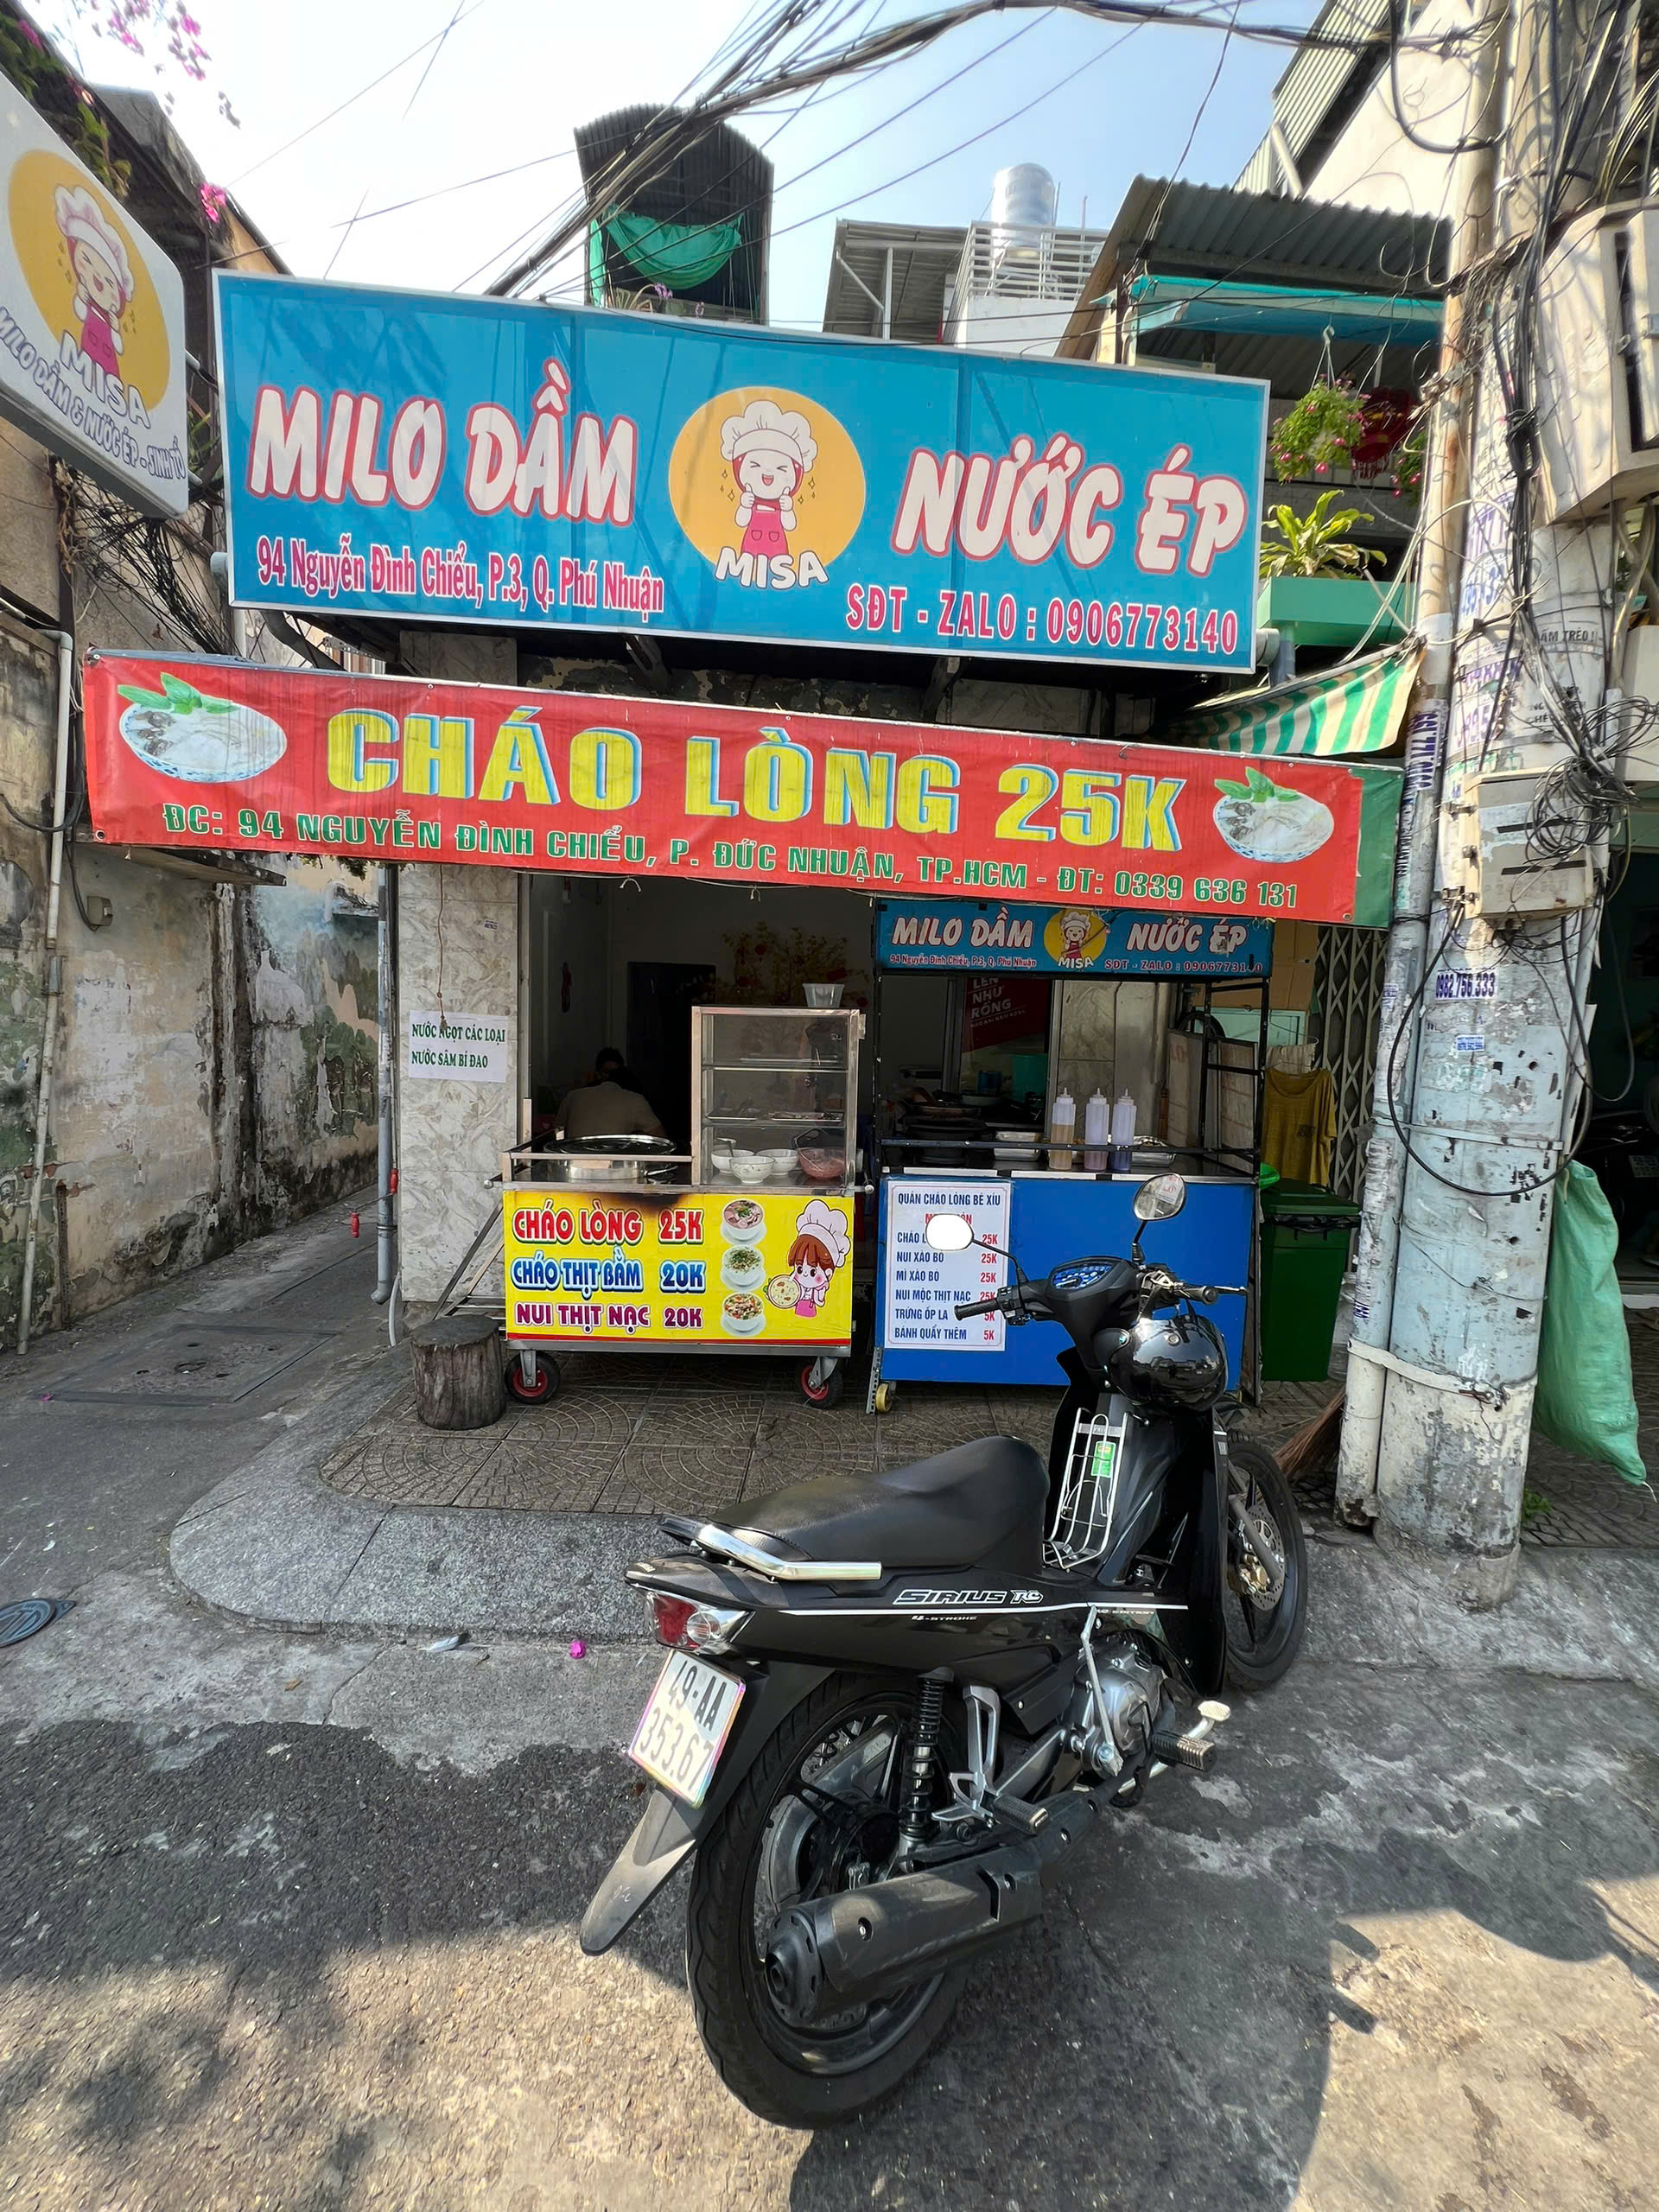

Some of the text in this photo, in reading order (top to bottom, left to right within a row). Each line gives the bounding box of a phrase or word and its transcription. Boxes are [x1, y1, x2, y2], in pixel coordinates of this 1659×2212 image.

[0, 306, 37, 370] MILO
[60, 329, 151, 429] MISA
[249, 359, 635, 524] MILO DẦM
[893, 432, 1249, 576] NƯỚC ÉP
[257, 533, 664, 623] 94 Nguyễn Đình Chiểu, P.3, Q. Phú Nhuận
[715, 546, 830, 589] MISA
[845, 582, 908, 632] SĐT
[937, 589, 1017, 641] ZALO
[1046, 597, 1238, 654] 0906773140
[327, 705, 1187, 852] CHÁO LÒNG 25K
[162, 803, 223, 835] ĐC:
[238, 809, 283, 839] 94
[296, 809, 442, 849] NGUYỄN
[454, 821, 534, 856] ĐÌNH
[547, 825, 657, 867] CHIỂU,
[670, 838, 699, 866] P.
[713, 838, 776, 870] ĐỨC
[788, 846, 905, 883] NHUẬN,
[917, 856, 1027, 888] TP.HCM
[1057, 866, 1104, 893] ĐT:
[1115, 871, 1184, 899] 0339
[1193, 877, 1248, 904] 636
[1257, 881, 1298, 908] 131
[892, 906, 1034, 948] MILO DẦM
[1126, 917, 1204, 952] NƯỚC
[890, 953, 900, 963] 94
[1058, 957, 1095, 969] MISA
[1104, 958, 1129, 969] SĐT
[1141, 960, 1173, 971] ZALO
[1435, 972, 1496, 998] 0982.756.333
[412, 1021, 436, 1038] NƯỚC
[465, 1024, 482, 1041] CÁC
[485, 1028, 505, 1046] LOẠI
[411, 1048, 488, 1068] NƯỚC SÂM BÍ ĐAO
[898, 1191, 1001, 1206] QUÁN CHÁO LÒNG BÉ XÍU
[513, 1198, 703, 1245] CHÁO LÒNG 25K
[897, 1230, 919, 1243] CHÁO
[982, 1234, 998, 1245] 25K
[896, 1250, 912, 1262] NUI
[913, 1249, 931, 1262] XÀO
[982, 1253, 997, 1264] 25K
[512, 1250, 561, 1291] CHÁO
[561, 1258, 601, 1300] THỊT
[660, 1259, 706, 1293] 20K
[896, 1268, 995, 1283] MÌ XÀO BÒ 25K
[895, 1289, 910, 1300] NUI
[933, 1290, 951, 1303] THỊT
[953, 1290, 971, 1304] NẠC
[895, 1306, 922, 1319] TRỨNG
[925, 1306, 936, 1319] ỐP
[938, 1309, 948, 1320] LA
[516, 1302, 703, 1334] NUI THỊT NẠC 20K
[894, 1325, 918, 1338] BÁNH
[944, 1326, 967, 1340] THÊM
[983, 1330, 995, 1340] 5K
[893, 1589, 1044, 1605] SIRIUS RC
[668, 1660, 727, 1732] 49-AA
[639, 1707, 715, 1792] 353.67
